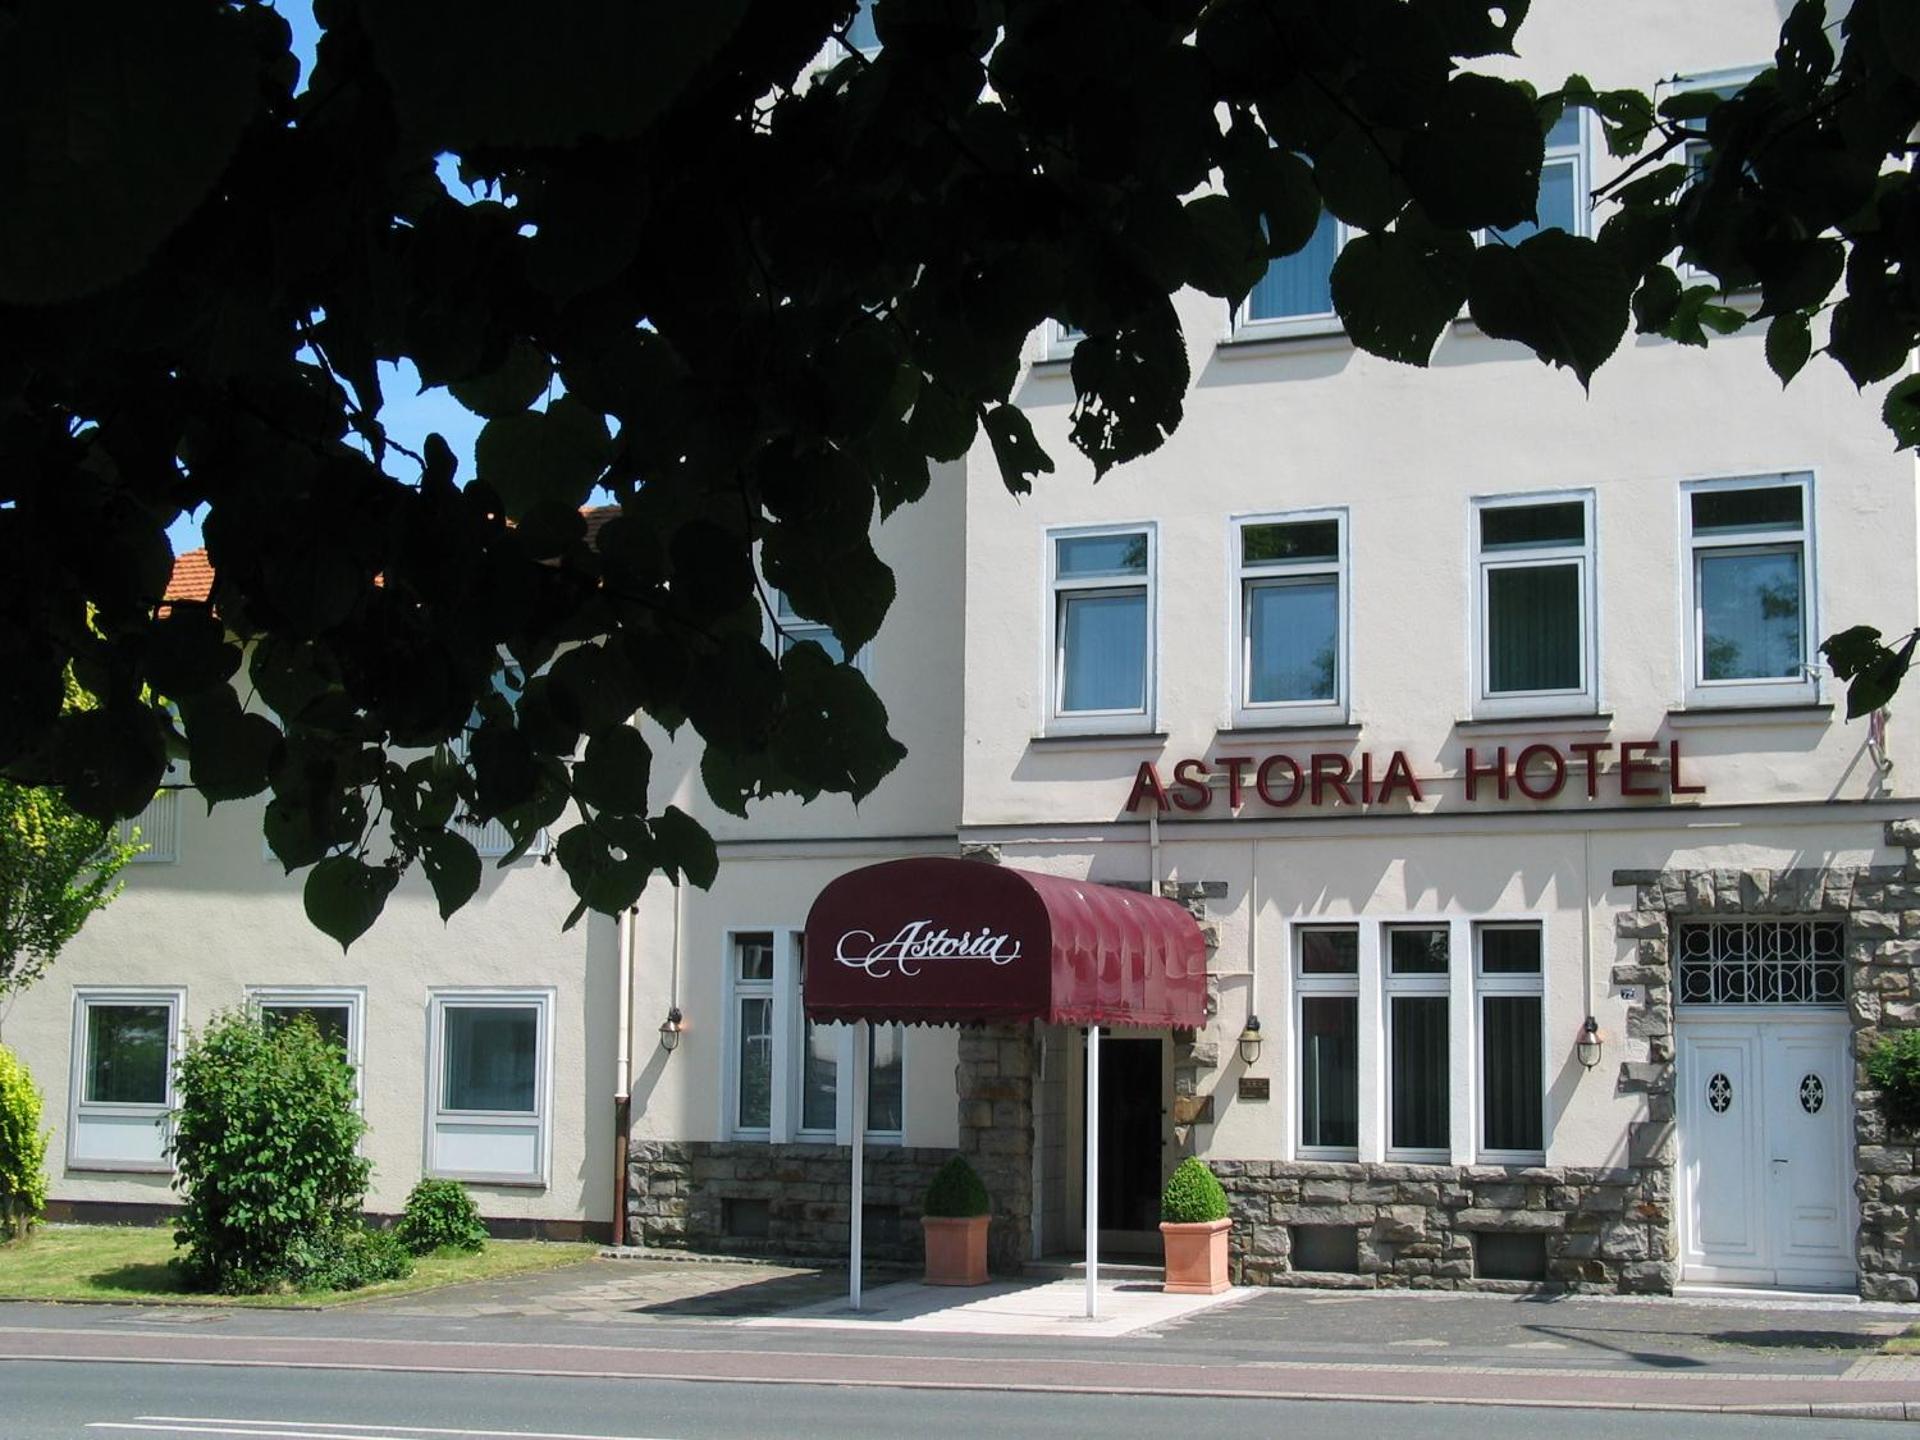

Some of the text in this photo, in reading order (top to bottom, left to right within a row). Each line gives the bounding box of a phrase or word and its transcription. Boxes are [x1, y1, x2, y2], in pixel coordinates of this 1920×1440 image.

[1126, 740, 1706, 812] ASTORIA HOTEL
[834, 919, 1022, 978] Astoria
